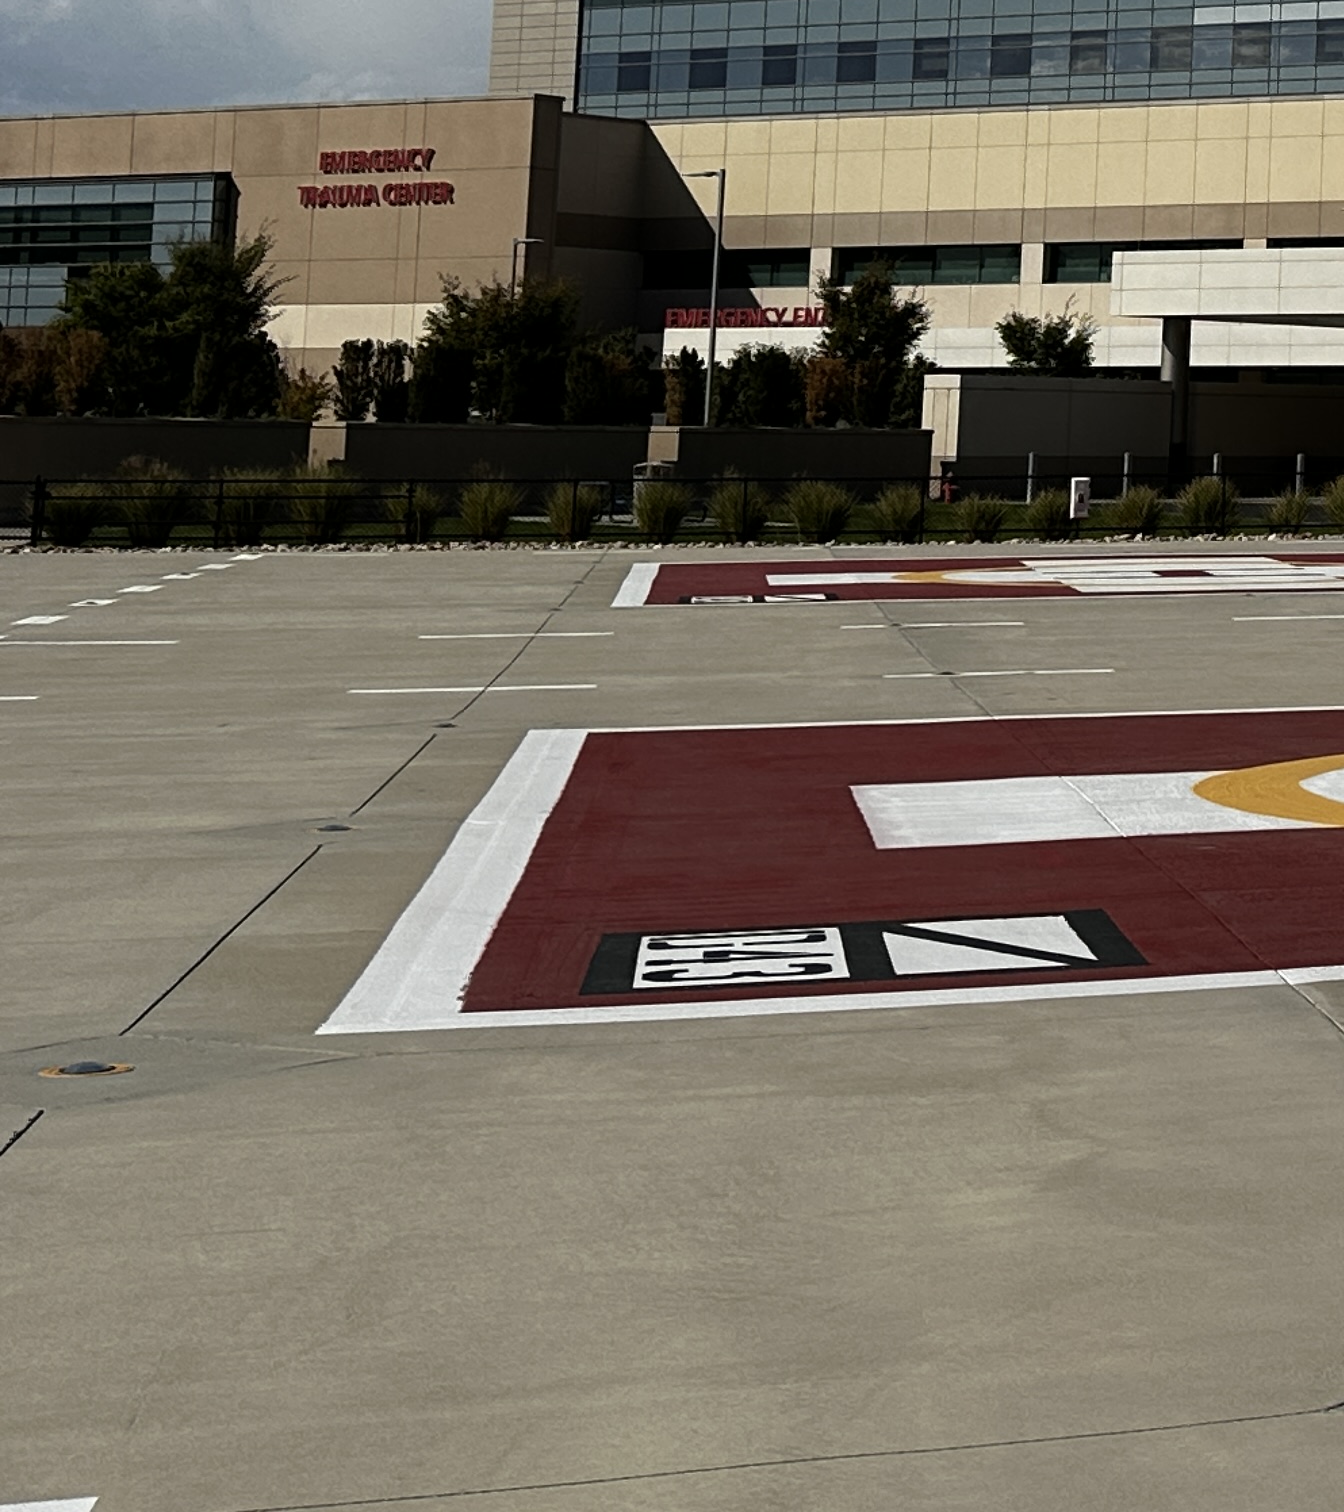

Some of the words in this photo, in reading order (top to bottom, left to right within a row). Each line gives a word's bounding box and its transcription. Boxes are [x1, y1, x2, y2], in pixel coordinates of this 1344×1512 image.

[319, 148, 436, 174] EMERGENCY
[297, 183, 381, 209] TRAUMA
[382, 181, 455, 207] CENTER
